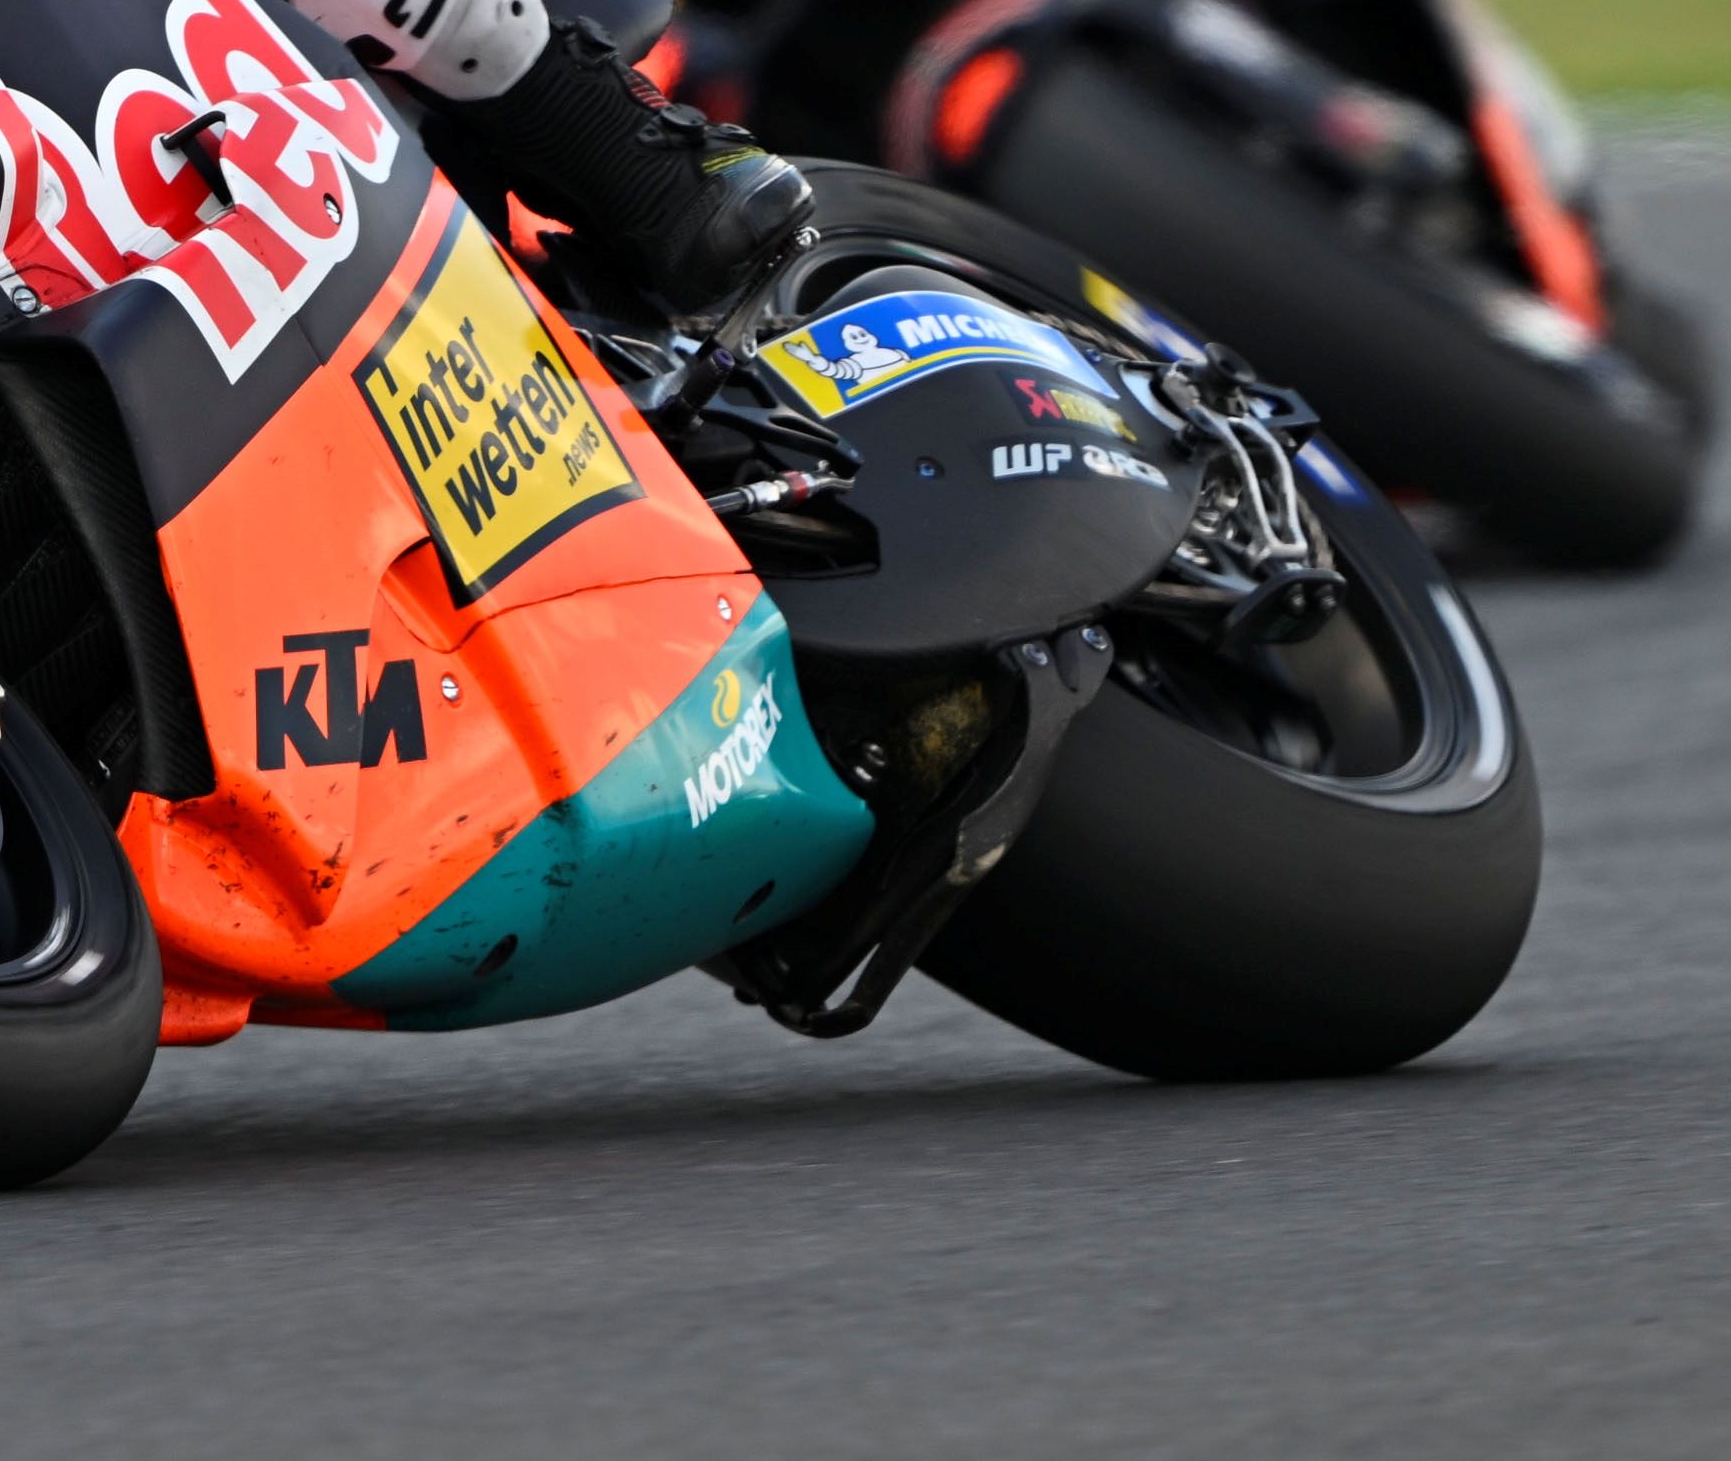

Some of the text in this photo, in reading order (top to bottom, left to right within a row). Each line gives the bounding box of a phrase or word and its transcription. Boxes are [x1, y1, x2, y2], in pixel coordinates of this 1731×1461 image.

[379, 315, 495, 472] inter
[444, 350, 576, 537] wetten
[991, 442, 1073, 479] WP
[254, 629, 428, 771] KTM
[684, 668, 783, 829] MOTOREX
